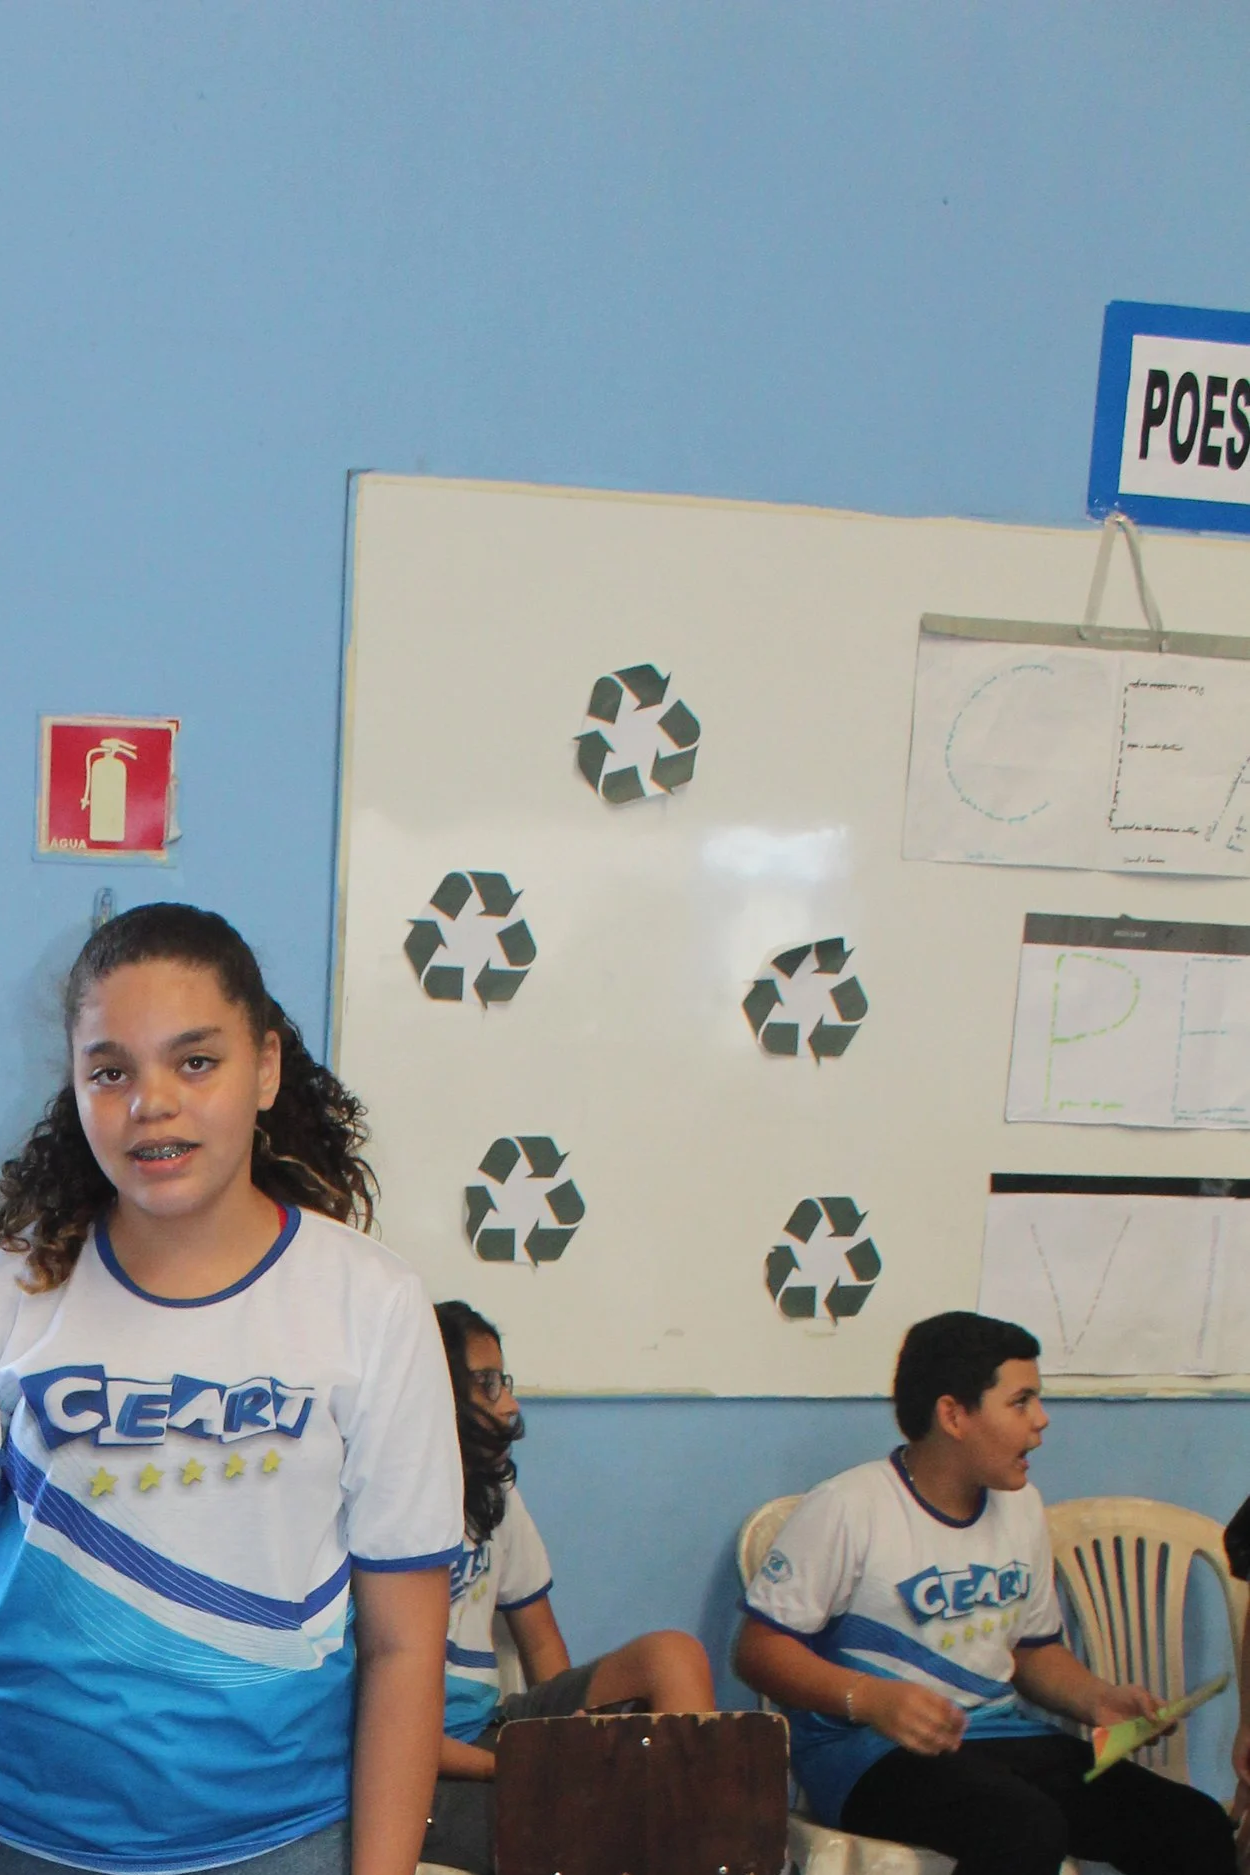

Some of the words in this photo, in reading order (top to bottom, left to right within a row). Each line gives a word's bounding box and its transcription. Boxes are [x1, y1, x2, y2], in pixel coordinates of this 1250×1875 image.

[1138, 369, 1250, 471] POES
[32, 1369, 317, 1444] CEART
[903, 1560, 1030, 1621] CEART
